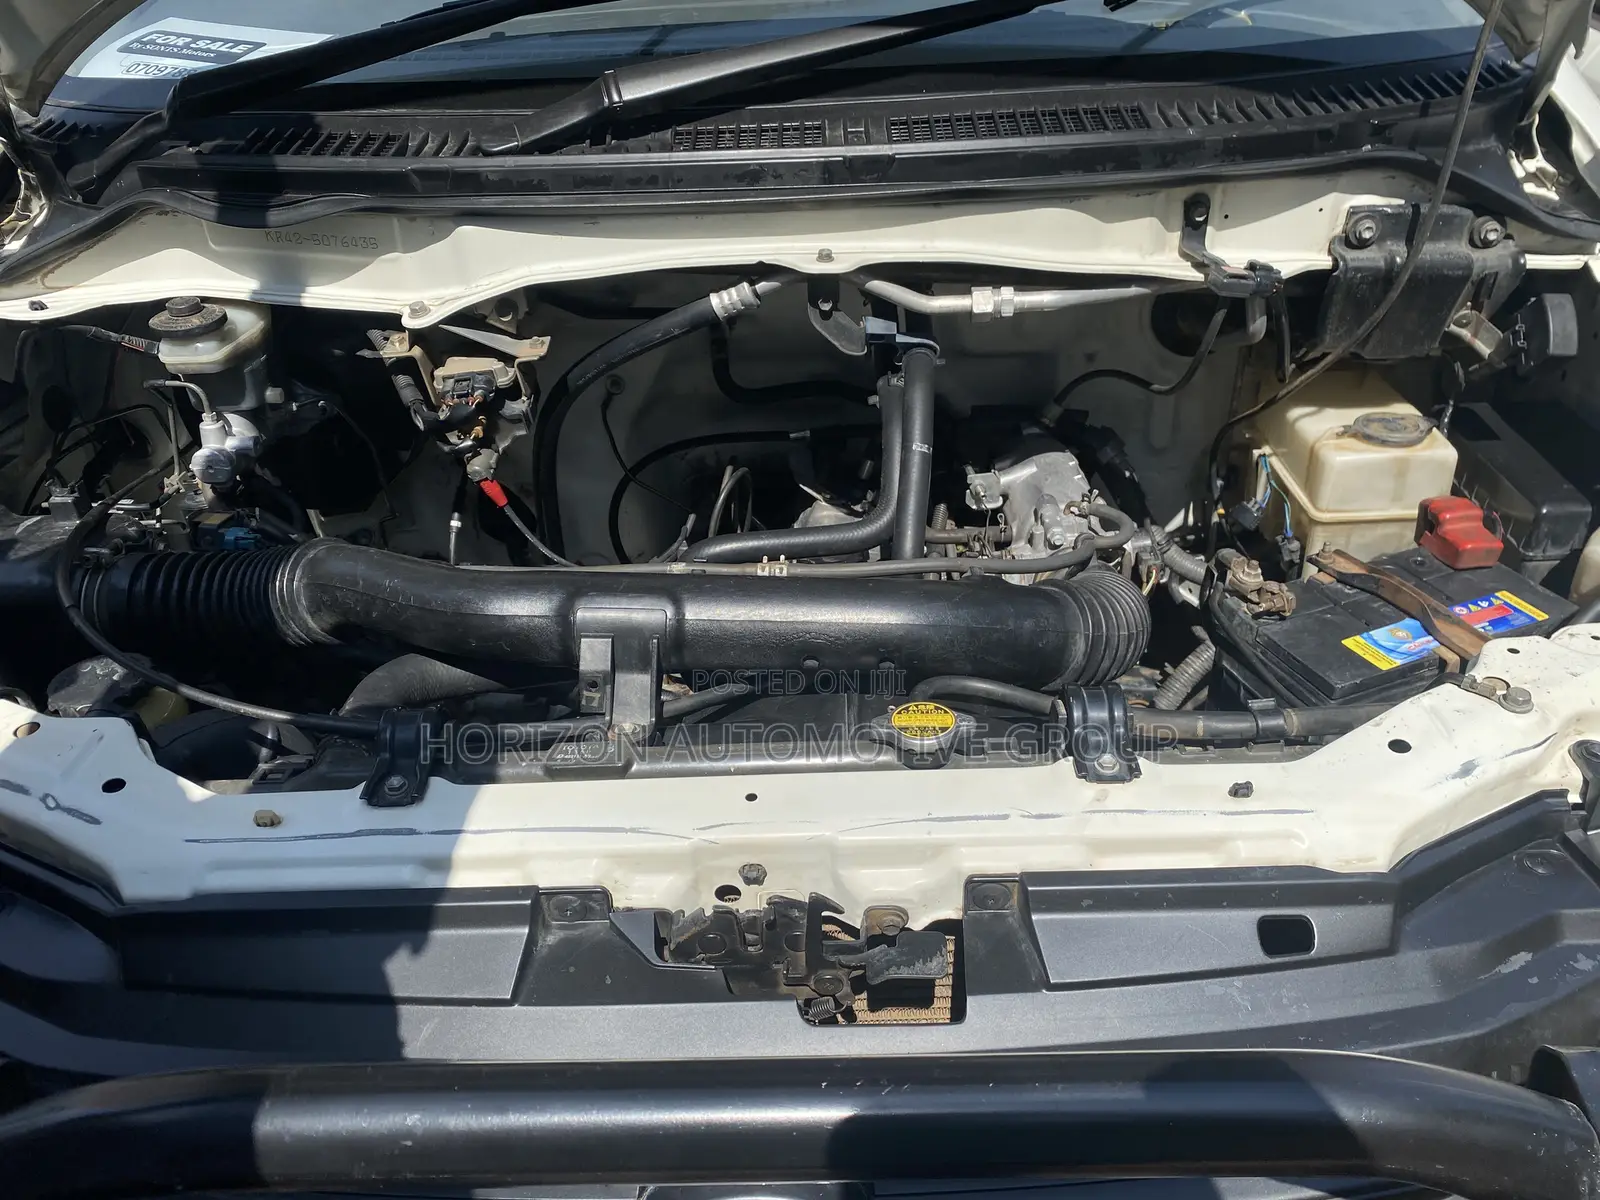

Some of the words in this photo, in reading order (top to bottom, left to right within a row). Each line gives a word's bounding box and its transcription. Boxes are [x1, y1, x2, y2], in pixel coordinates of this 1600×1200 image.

[128, 42, 142, 50] By
[179, 48, 217, 58] Motors
[141, 33, 192, 46] FOR
[189, 39, 254, 53] SALE
[264, 230, 379, 249] KR42-5076435
